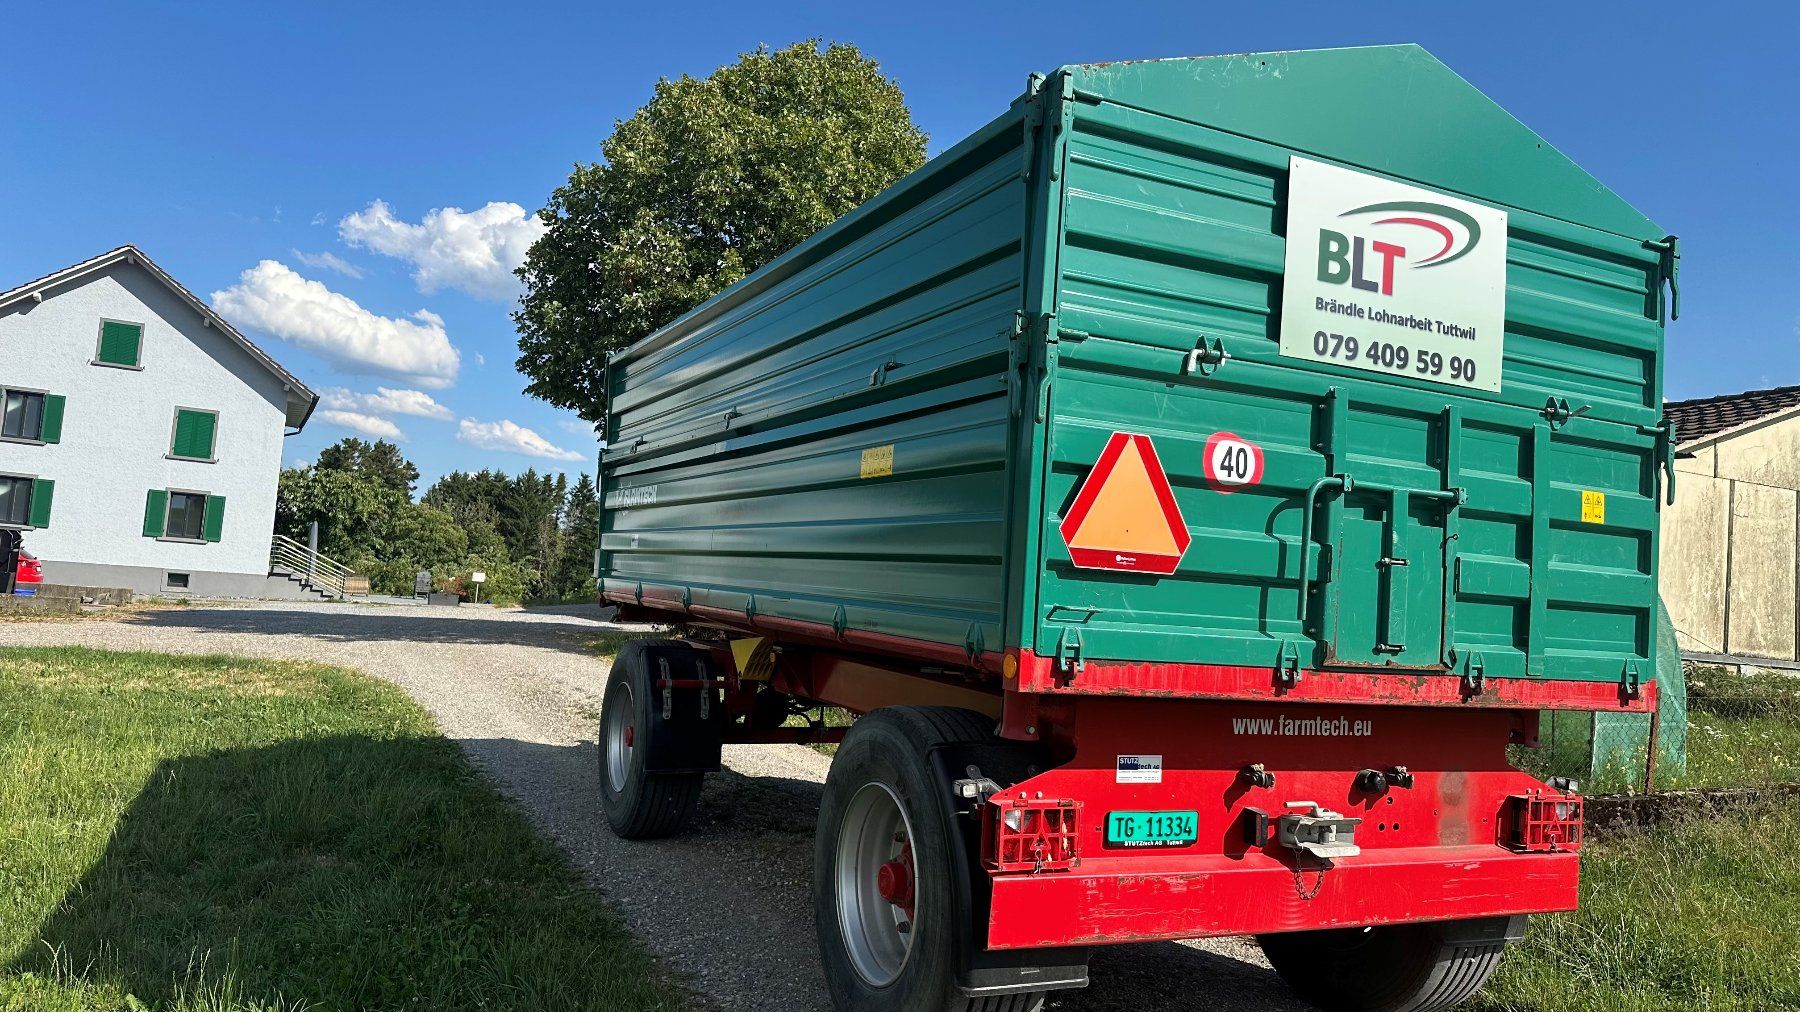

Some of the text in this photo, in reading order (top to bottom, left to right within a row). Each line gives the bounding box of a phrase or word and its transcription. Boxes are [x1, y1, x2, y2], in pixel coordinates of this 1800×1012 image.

[1317, 228, 1406, 296] BLT
[1315, 297, 1476, 340] Brändle Lohnarbeit Tuttwil
[1313, 331, 1476, 382] 079 409 59 90
[1220, 446, 1248, 479] 40
[1232, 714, 1372, 737] www.farmtech.eu
